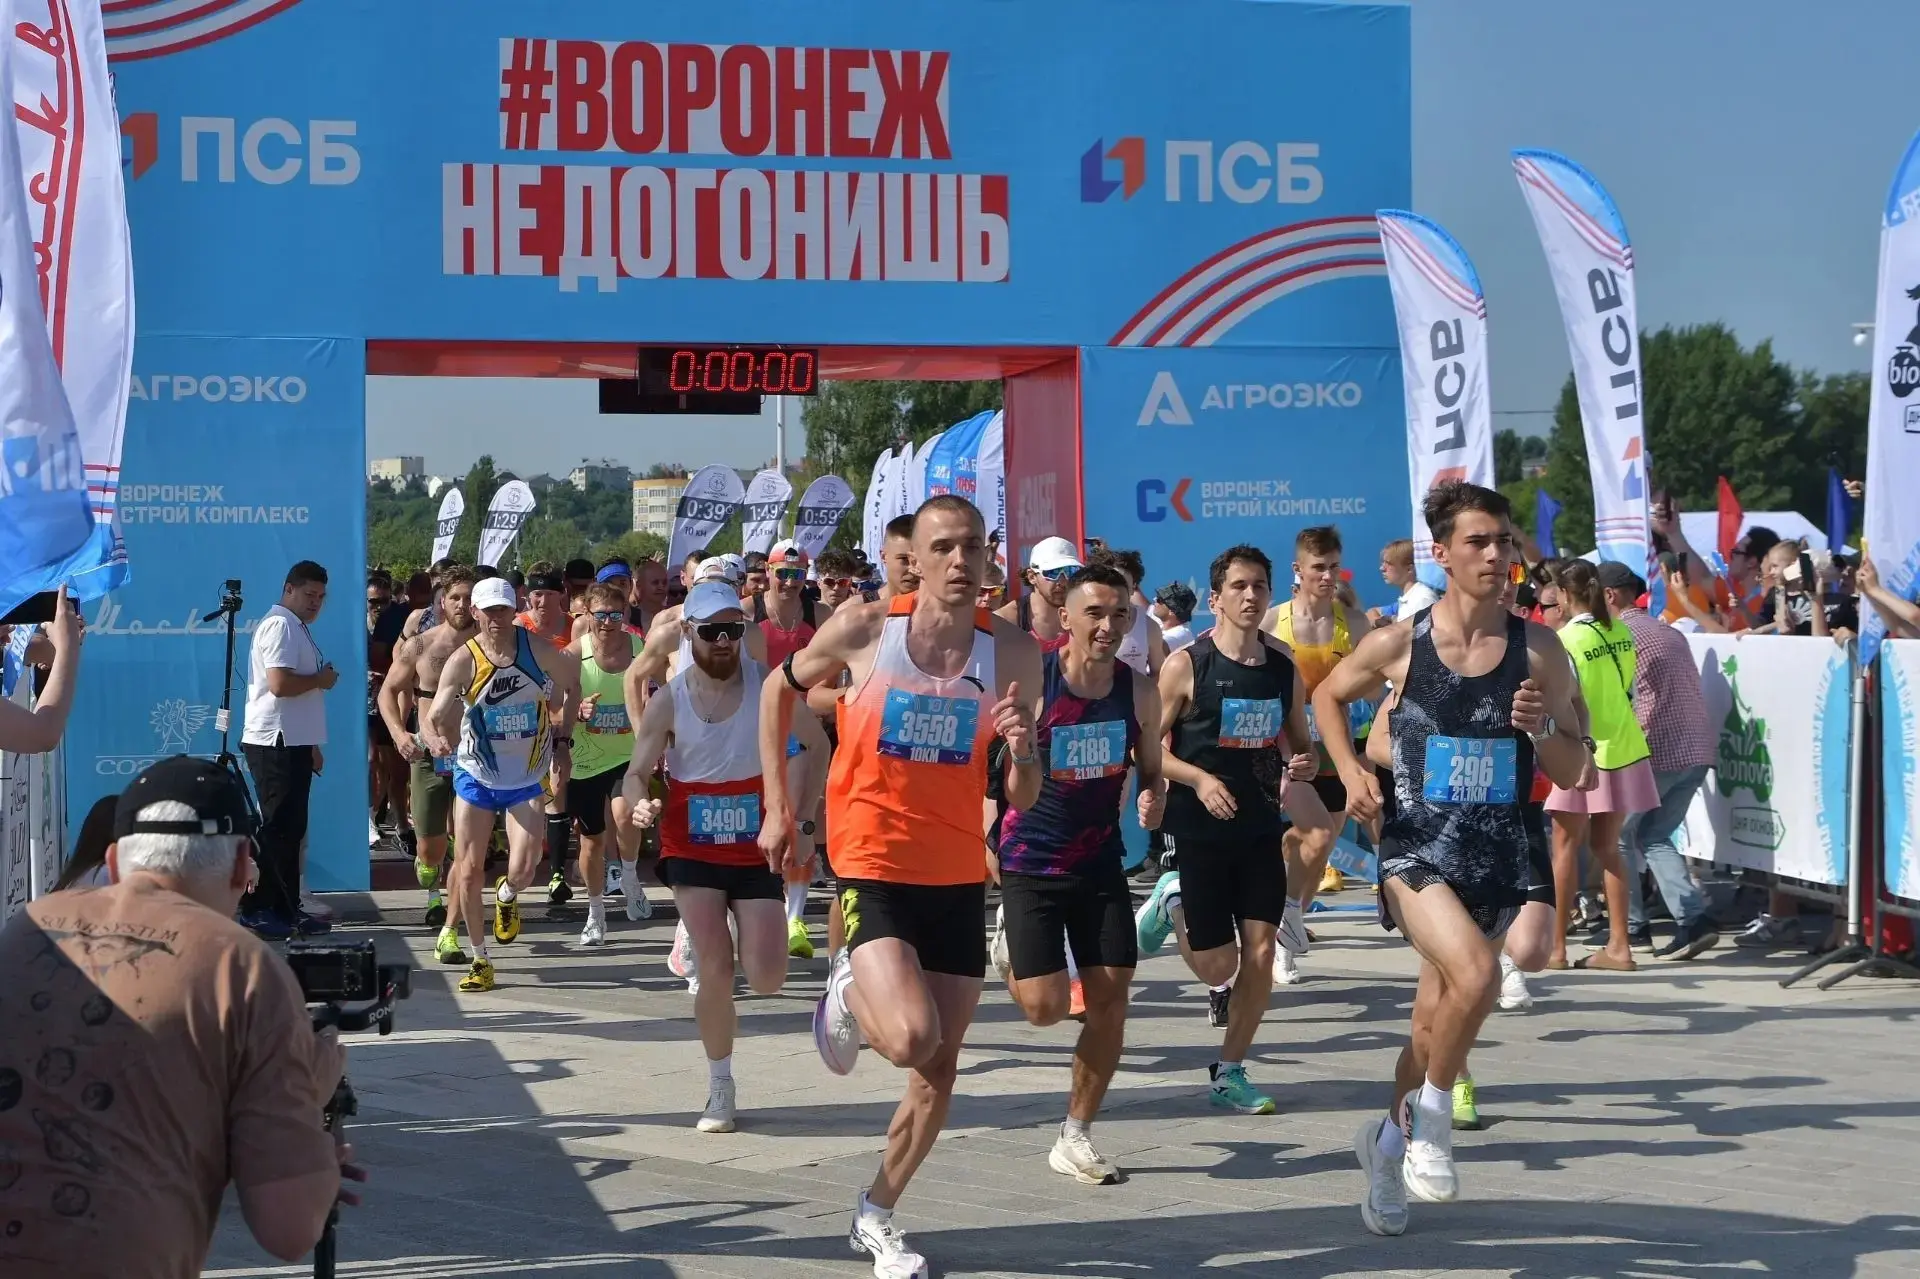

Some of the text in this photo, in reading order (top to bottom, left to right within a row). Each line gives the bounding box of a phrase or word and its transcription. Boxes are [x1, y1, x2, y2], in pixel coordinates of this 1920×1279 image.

[500, 38, 952, 159] #ВОРОНЕЖ
[181, 116, 361, 185] ПСБ
[1165, 140, 1324, 204] ПСБ
[670, 351, 814, 392] 0:00:00
[128, 375, 307, 403] АГРОЭКО
[1200, 382, 1361, 410] АГРОЭКО
[120, 484, 224, 503] ВОРОНЕЖ
[1201, 480, 1291, 498] ВОРОНЕЖ
[120, 503, 309, 524] СТРОЙ КОМПЛЕКС
[687, 500, 725, 521] 0:39
[750, 503, 778, 521] 1:49
[804, 508, 837, 525] 0:59
[1201, 498, 1366, 517] СТРОЙ КОМПЛЕКС
[440, 519, 455, 536] 0:49
[492, 513, 518, 529] 1:29
[1584, 638, 1632, 661] ВОЛОНТЁР
[491, 675, 521, 694] NIKE
[495, 713, 529, 731] 3599
[594, 713, 624, 728] 2035
[898, 711, 958, 747] 3558
[1233, 712, 1272, 736] 2334
[910, 746, 940, 764] 10KM
[1066, 737, 1110, 766] 2188
[1074, 766, 1103, 780] 21.1KM
[1448, 755, 1494, 787] 296
[1451, 785, 1487, 802] 21.1KM
[701, 808, 746, 832] 3490
[713, 833, 736, 845] 10KM
